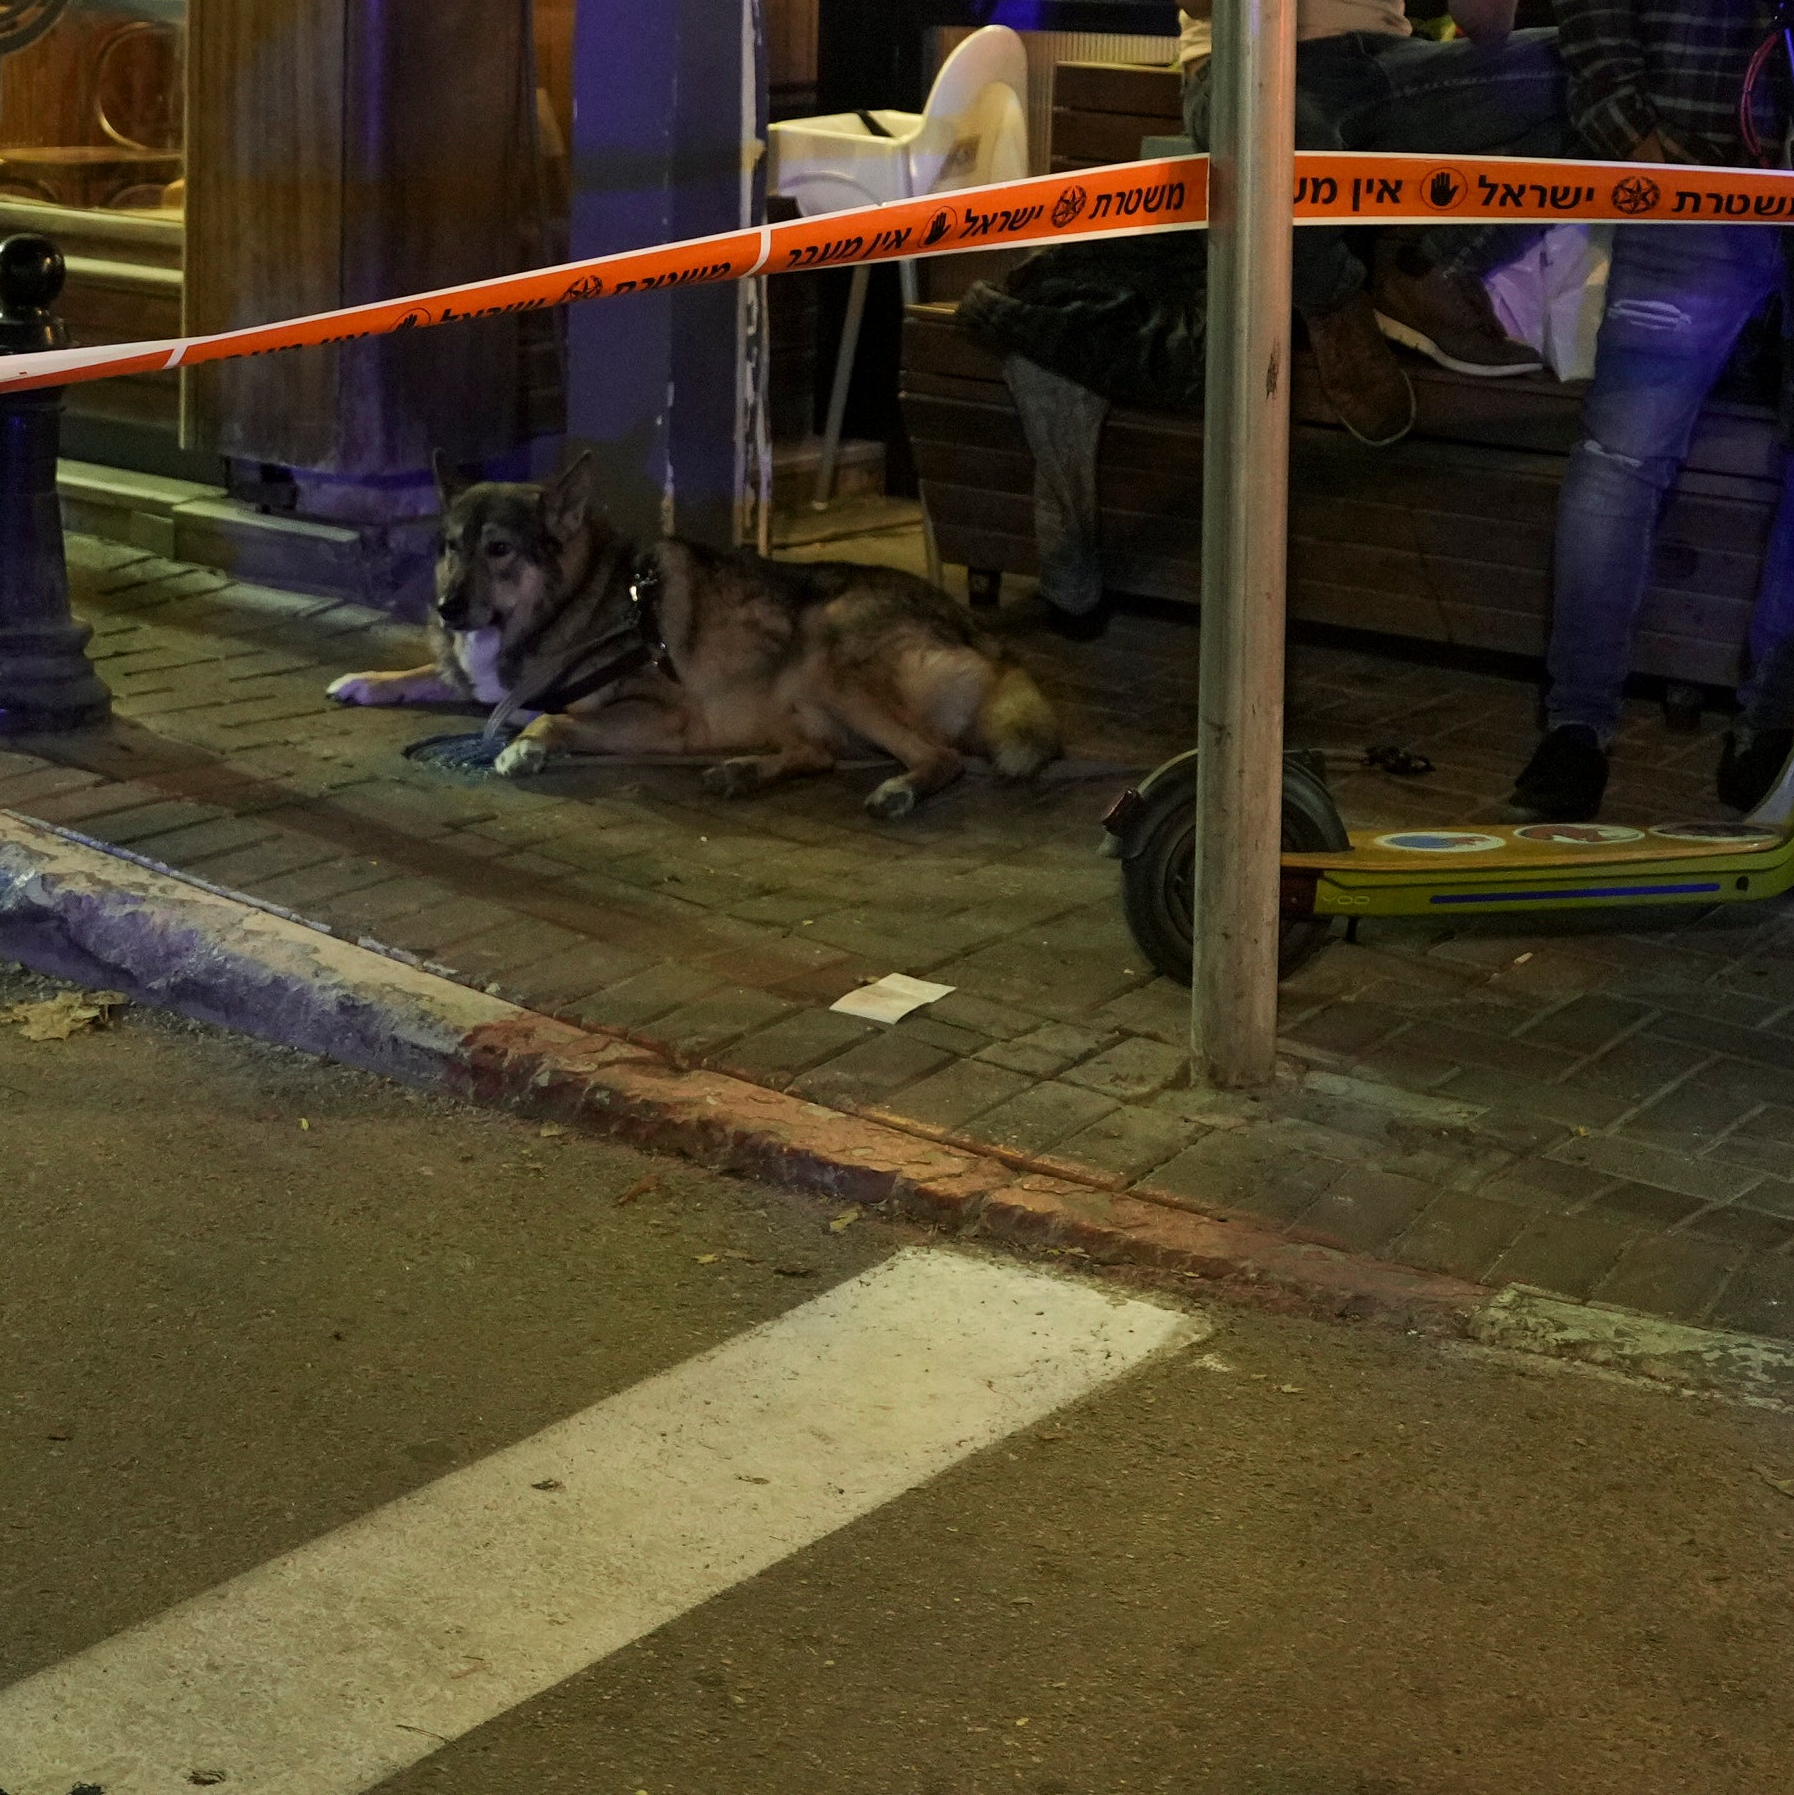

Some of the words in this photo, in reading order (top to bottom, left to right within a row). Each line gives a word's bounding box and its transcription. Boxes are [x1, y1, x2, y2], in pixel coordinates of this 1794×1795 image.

[1088, 181, 1185, 220] משטרת
[1293, 177, 1338, 204] מע
[1352, 178, 1403, 212] אין
[1478, 174, 1595, 210] ישראל
[958, 205, 1045, 240] ישראל
[786, 239, 864, 269] מעבר
[861, 226, 913, 259] אין
